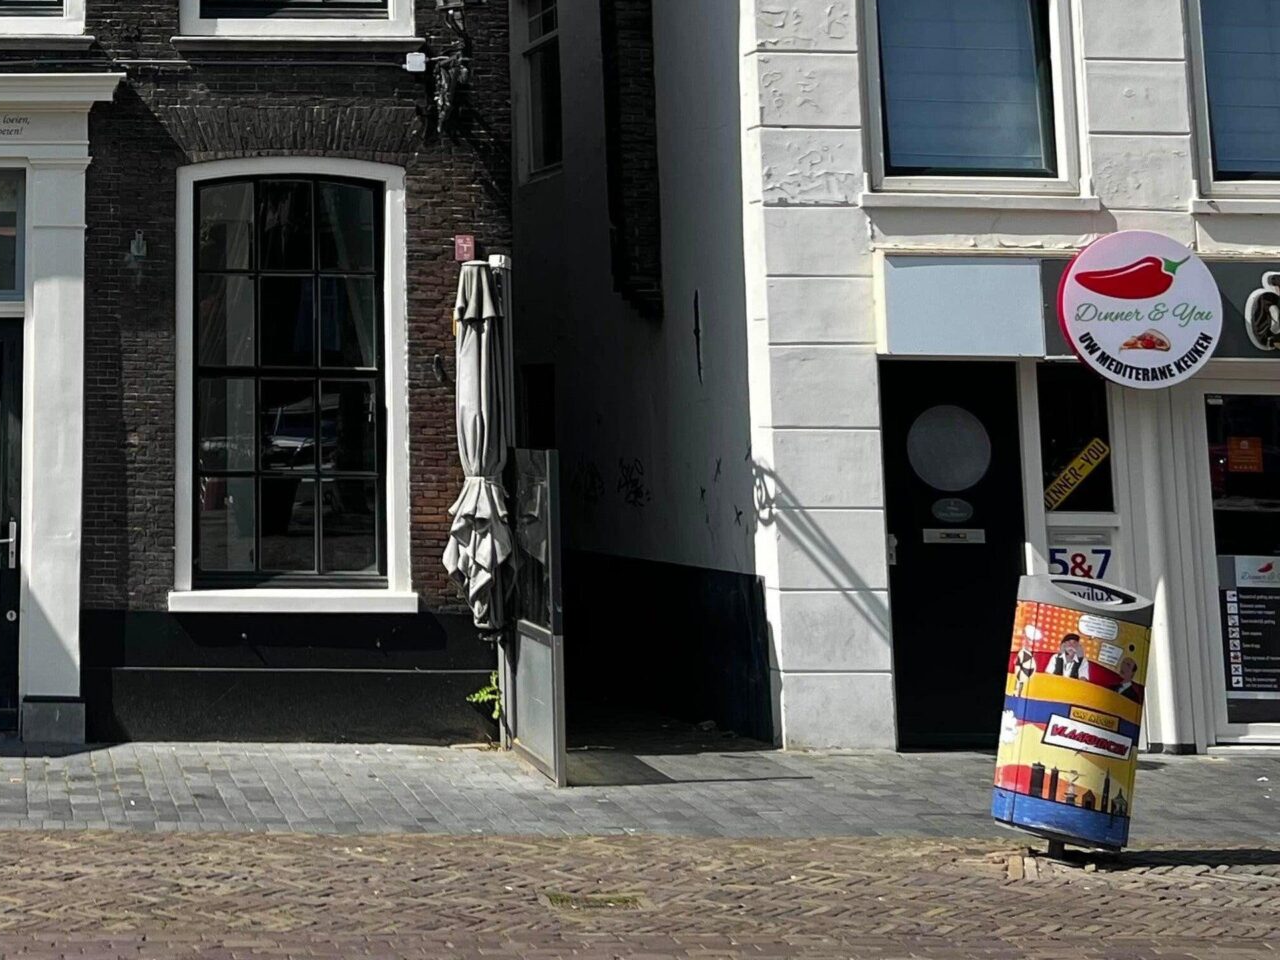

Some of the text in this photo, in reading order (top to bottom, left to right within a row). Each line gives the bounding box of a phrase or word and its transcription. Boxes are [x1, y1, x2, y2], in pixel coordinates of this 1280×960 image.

[1074, 302, 1214, 328] Dinner & You
[1078, 331, 1214, 382] UW MEDITERANE KEUKEN
